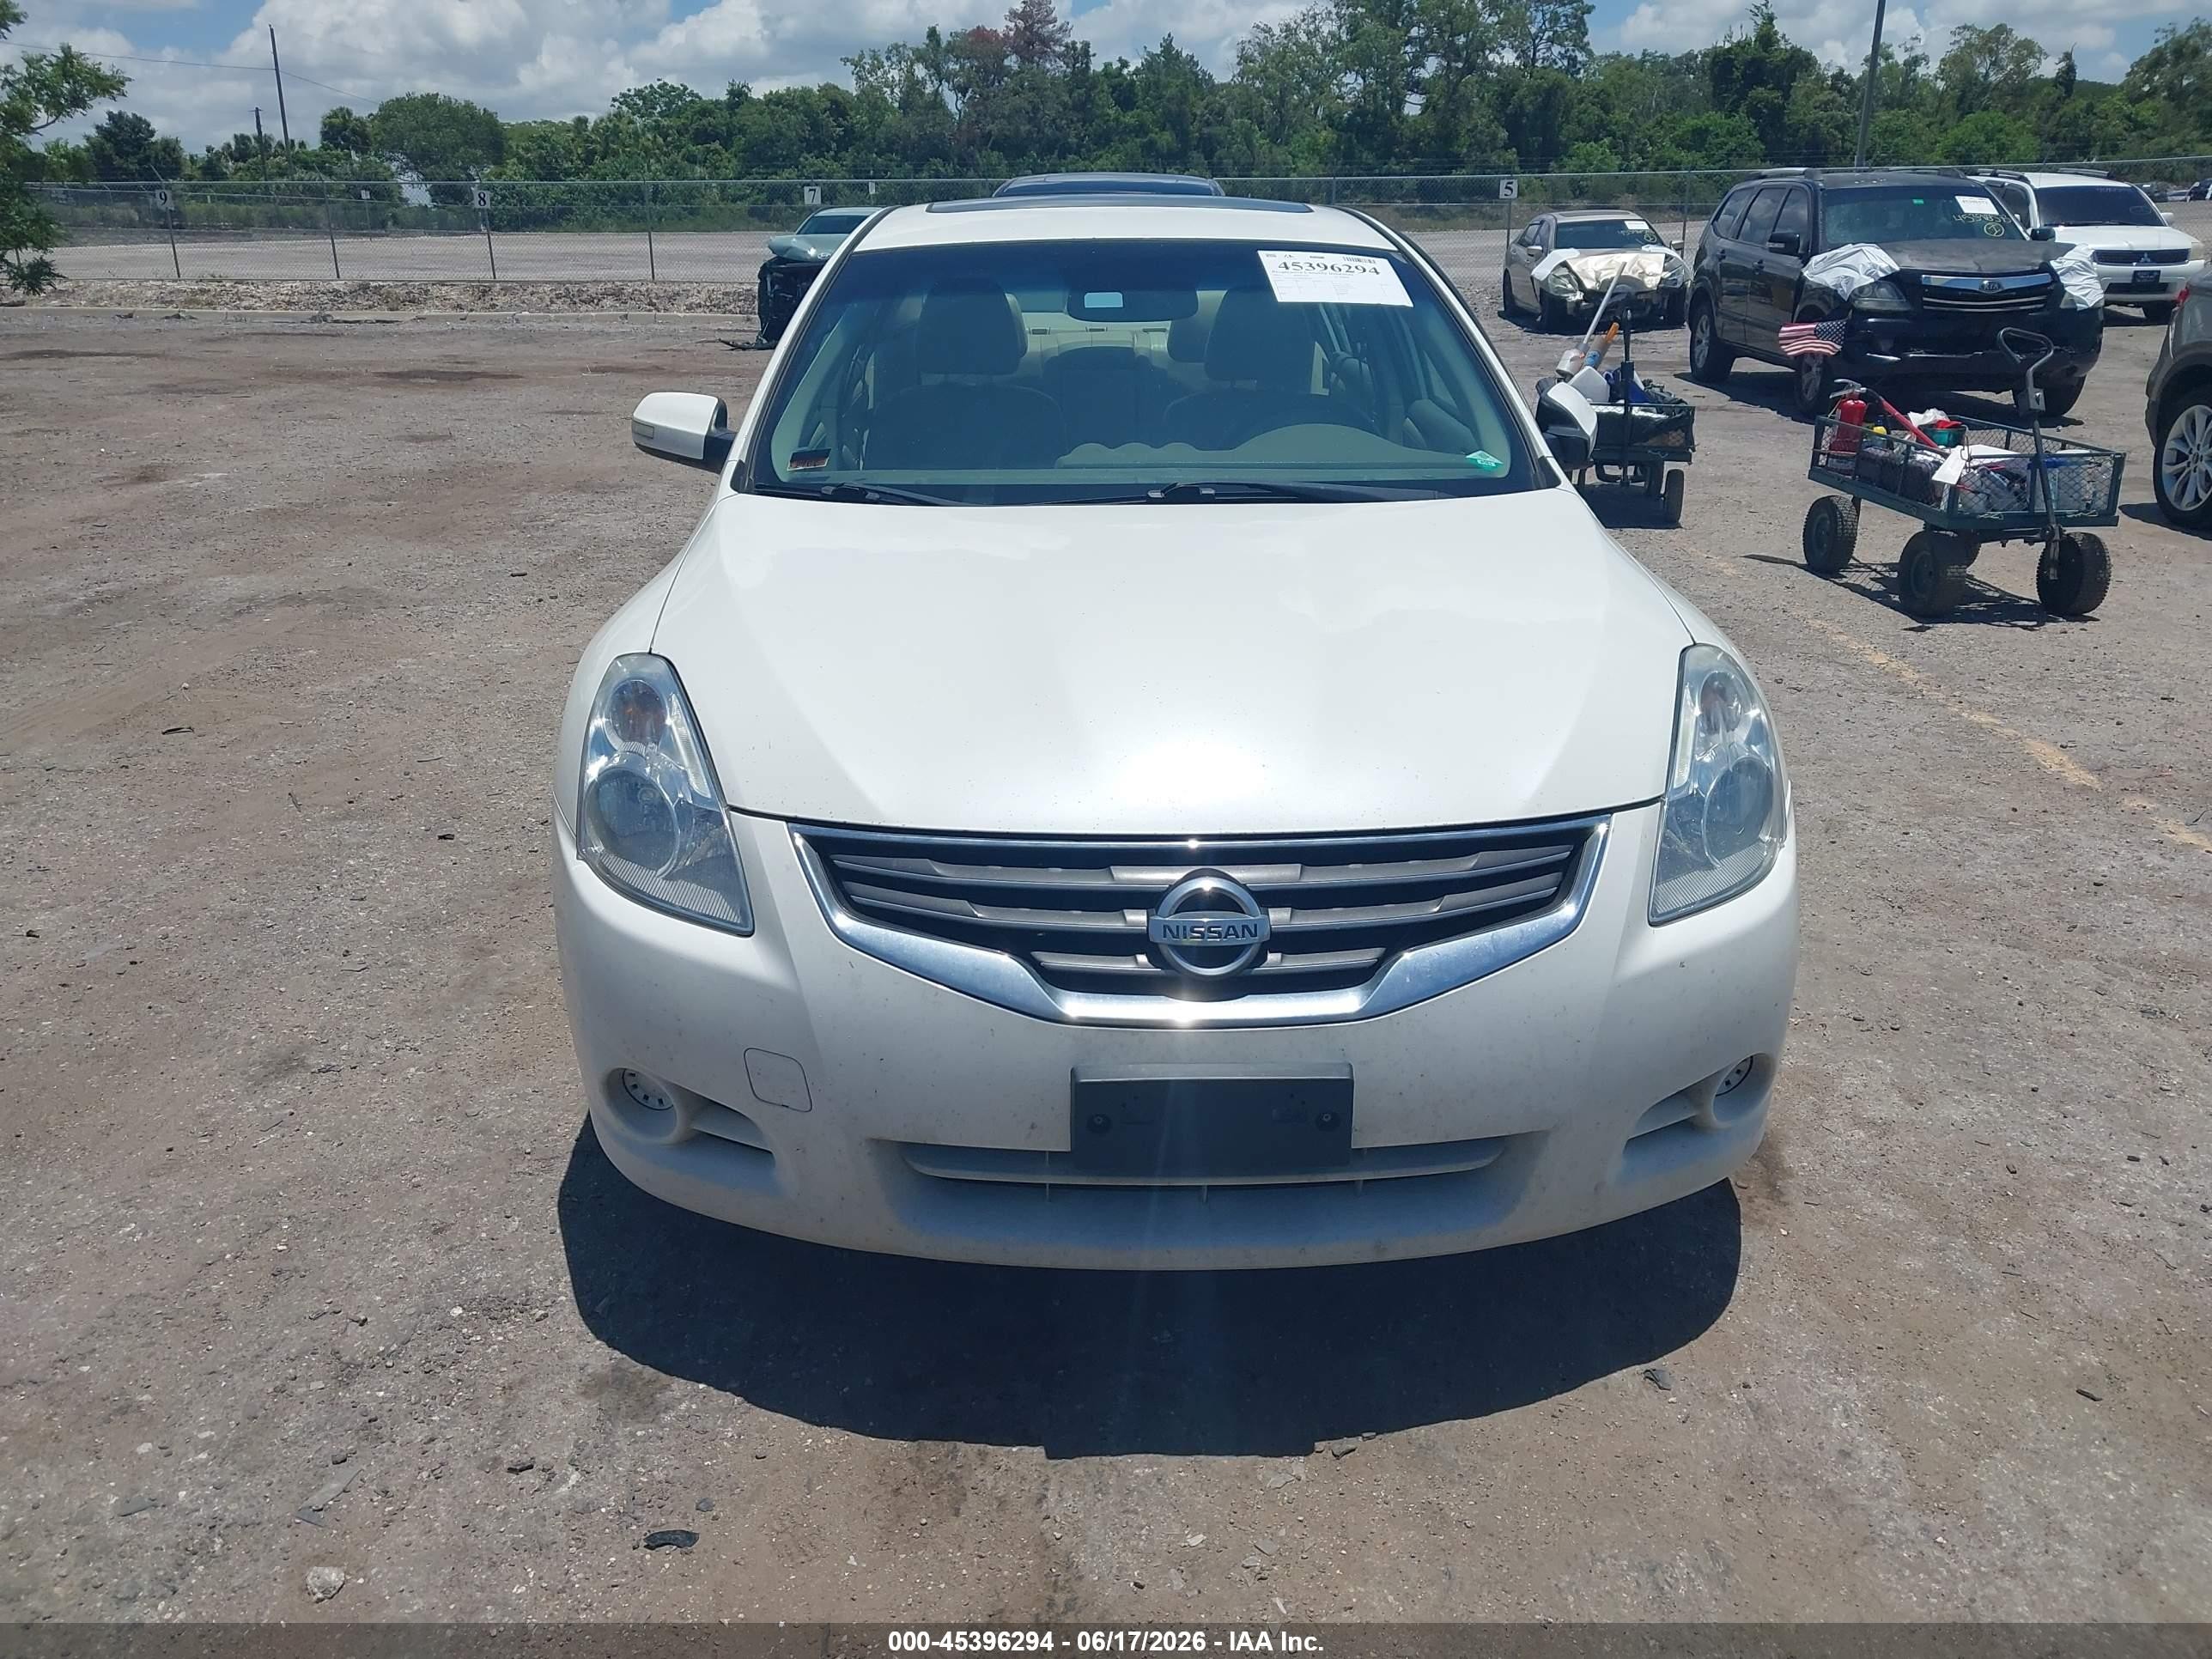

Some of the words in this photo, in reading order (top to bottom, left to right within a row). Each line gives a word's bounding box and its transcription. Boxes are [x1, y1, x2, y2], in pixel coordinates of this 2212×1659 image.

[807, 187, 817, 204] 7
[1504, 180, 1514, 197] 5
[159, 191, 167, 206] 9
[477, 191, 487, 207] 8
[1278, 261, 1381, 276] 45396294
[1163, 924, 1258, 939] NISSAN
